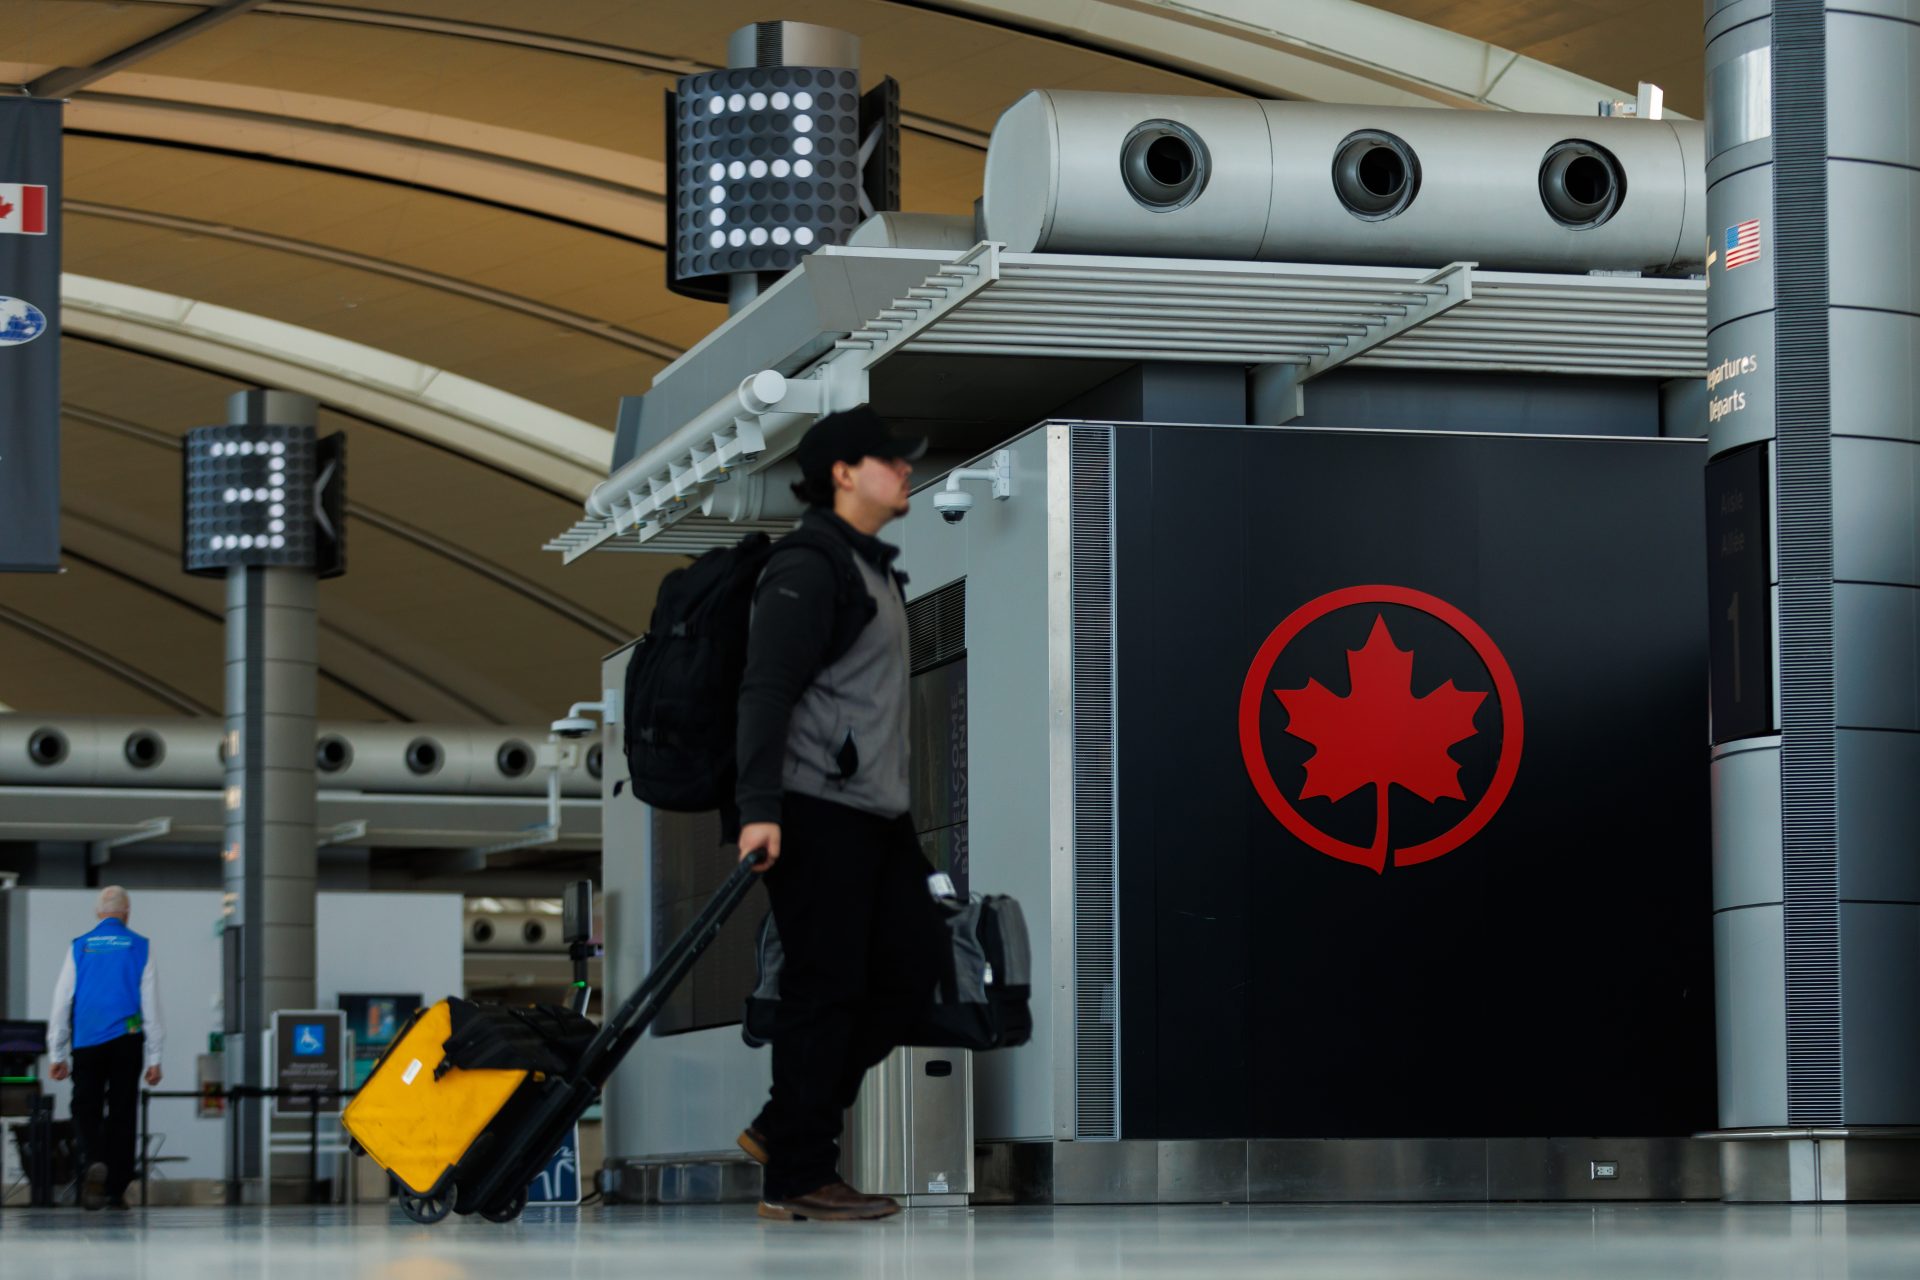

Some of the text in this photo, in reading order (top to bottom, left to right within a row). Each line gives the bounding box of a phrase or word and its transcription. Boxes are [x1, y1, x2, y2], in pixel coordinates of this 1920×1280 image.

[709, 91, 814, 249] 2
[1707, 355, 1757, 391] epartures
[1709, 389, 1746, 422] Départs
[209, 441, 286, 551] 3
[1720, 487, 1745, 516] Aisle
[1720, 528, 1745, 556] Allée
[1727, 591, 1741, 703] 1
[951, 693, 961, 865] WELCOME
